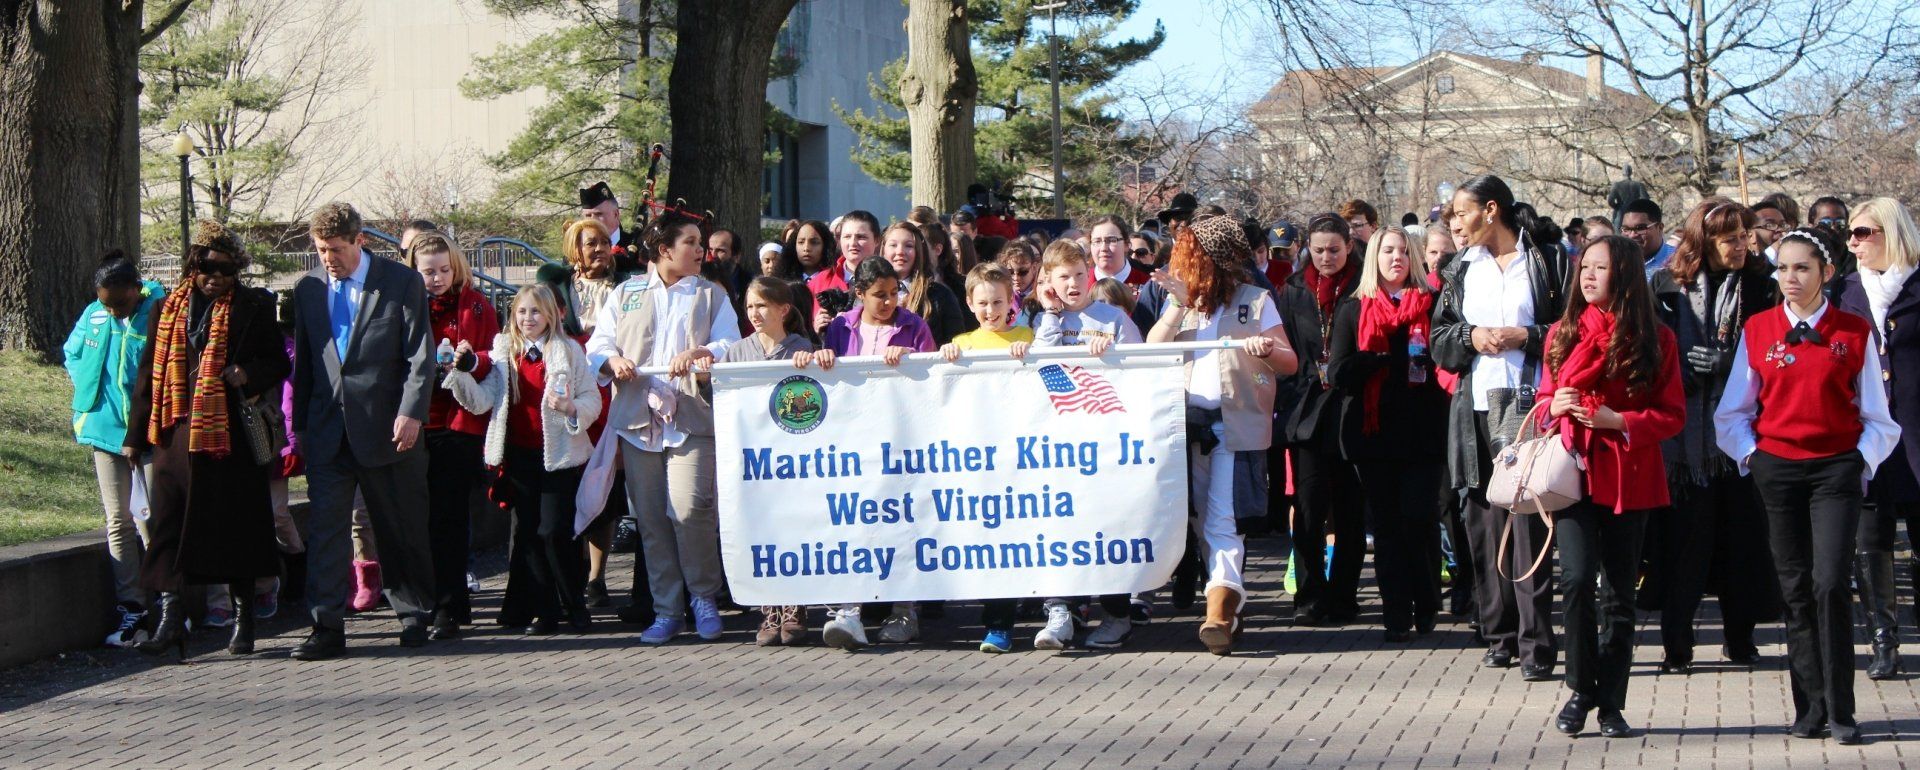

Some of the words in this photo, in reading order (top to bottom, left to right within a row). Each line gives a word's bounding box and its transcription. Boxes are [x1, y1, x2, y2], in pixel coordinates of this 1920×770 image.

[783, 375, 799, 384] STATE
[777, 421, 792, 432] WEST
[795, 420, 820, 434] VIRGINIA
[742, 444, 862, 481] Martin
[881, 440, 998, 475] Luther
[1016, 435, 1099, 476] King
[1118, 432, 1155, 467] Jr.
[826, 492, 915, 526] West
[931, 484, 1075, 529] Virginia
[751, 541, 896, 581] Holiday
[915, 531, 1155, 573] Commission
